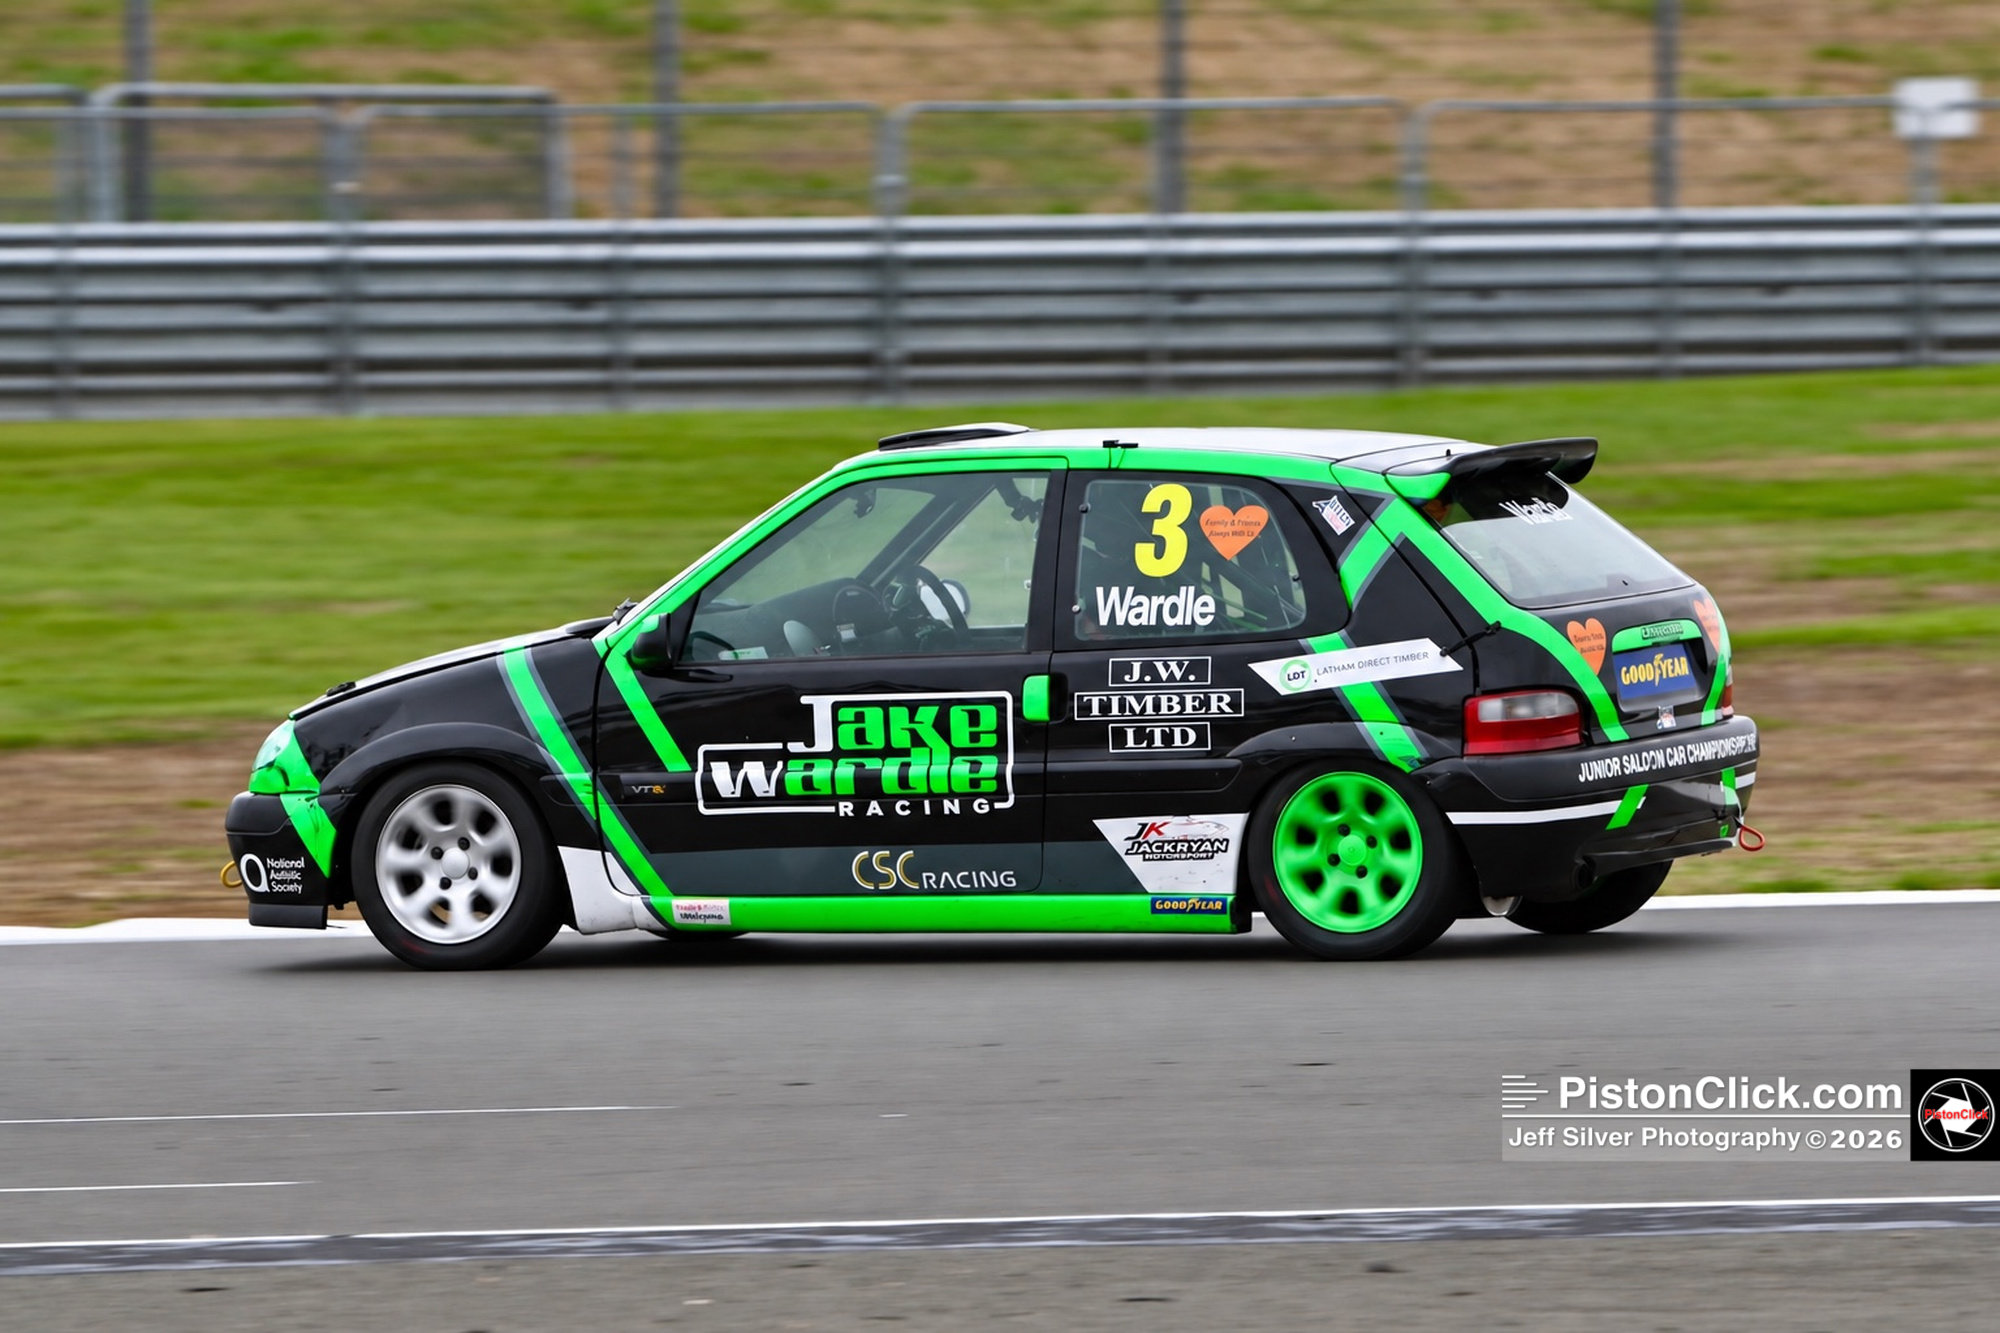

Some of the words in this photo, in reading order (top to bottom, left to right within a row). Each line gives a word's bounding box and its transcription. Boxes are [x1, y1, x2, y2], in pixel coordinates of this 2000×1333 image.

[1135, 483, 1193, 577] 3
[1096, 586, 1216, 627] Wardle
[1124, 660, 1196, 683] J.W.
[1287, 671, 1307, 681] LDT
[1317, 663, 1355, 676] LATHAM
[1358, 657, 1390, 669] DIRECT
[1393, 651, 1429, 664] TIMBER
[1621, 653, 1690, 686] GOODYEAR
[1083, 693, 1234, 717] TIMBER
[787, 695, 998, 754] Jake
[1124, 727, 1197, 749] LTD
[1578, 757, 1621, 782] JUNIOR
[1666, 746, 1687, 767] CAR
[838, 798, 990, 817] RACING
[1124, 822, 1171, 840] JK
[266, 856, 305, 868] National
[852, 850, 919, 890] CSC
[922, 870, 1017, 889] RACING
[271, 881, 302, 894] Society
[1155, 898, 1223, 911] GOODYEAR
